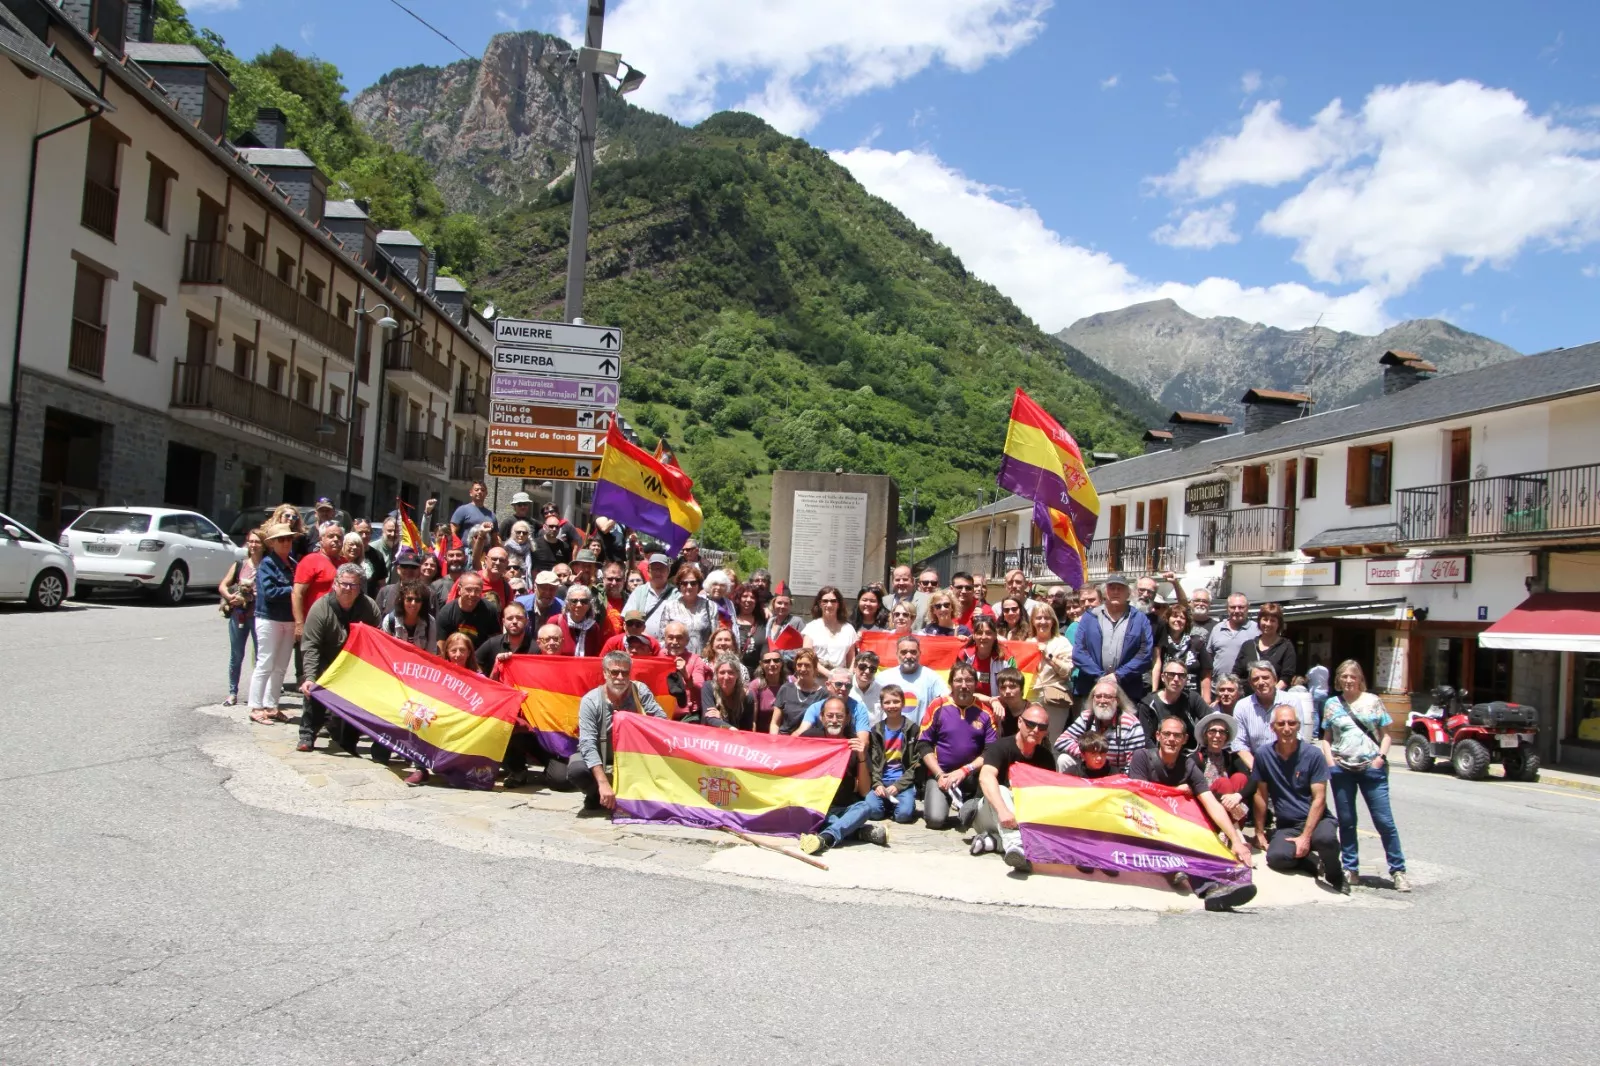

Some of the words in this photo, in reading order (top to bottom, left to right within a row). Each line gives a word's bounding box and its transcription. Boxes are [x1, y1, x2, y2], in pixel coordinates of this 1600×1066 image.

[499, 326, 552, 339] JAVIERRE
[497, 353, 554, 366] ESPIERBA
[496, 378, 511, 386] Arte
[512, 380, 517, 388] y
[518, 380, 554, 389] Naturaleza
[495, 404, 517, 412] Valle
[494, 412, 533, 424] Pineta
[491, 428, 512, 437] pista
[515, 431, 537, 439] esquí
[553, 432, 576, 441] fondo
[491, 438, 501, 446] 14
[505, 439, 518, 447] Km
[492, 464, 526, 475] Monte
[529, 466, 569, 477] Perdido
[393, 662, 442, 683] EJERCITO
[441, 673, 484, 711] POPULAR
[1110, 850, 1128, 865] 13
